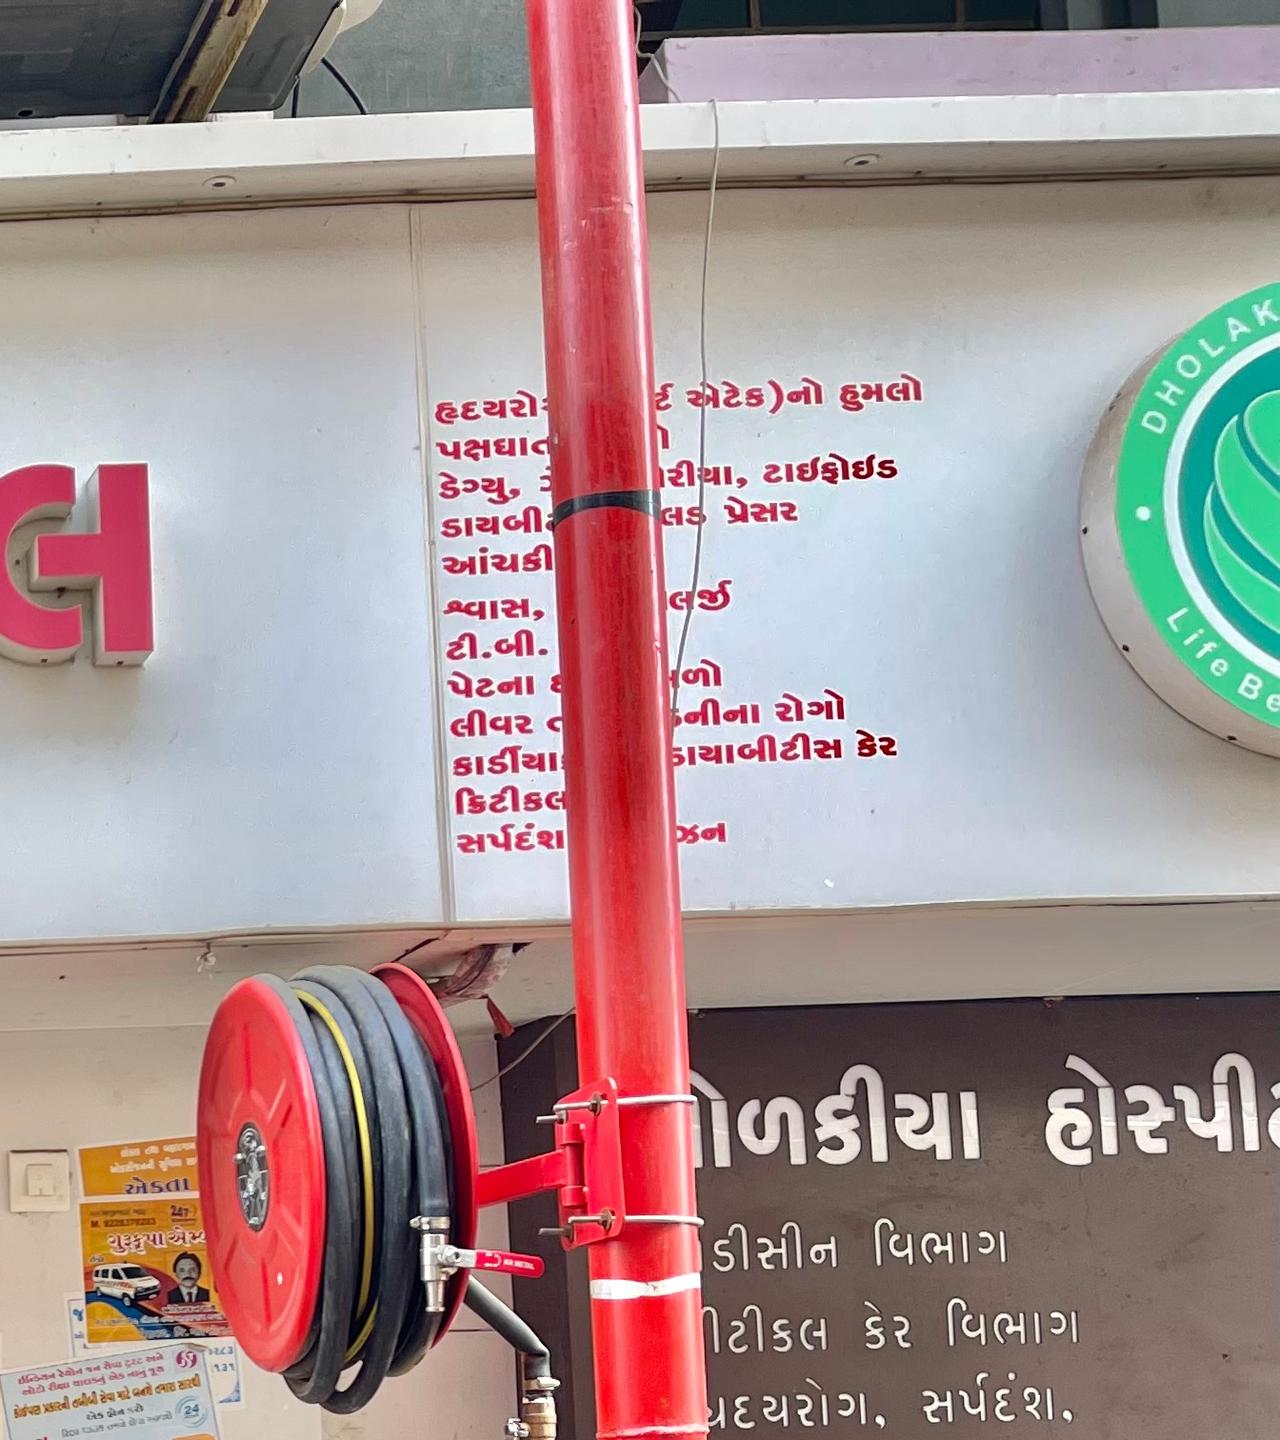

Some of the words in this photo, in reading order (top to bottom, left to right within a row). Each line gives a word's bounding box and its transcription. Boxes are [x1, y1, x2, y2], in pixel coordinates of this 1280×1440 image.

[840, 373, 923, 412] હુમલો
[762, 452, 898, 485] ટાઈફોઈડ
[446, 628, 548, 661] ટી.બી.
[1166, 606, 1230, 679] Life
[447, 670, 536, 699] પેટના
[450, 708, 534, 738] લીવર
[774, 688, 845, 723] રોગો
[452, 745, 567, 777] કાર્ડીયા
[855, 729, 897, 758] કેર
[689, 1063, 981, 1168] ોળકીયા
[699, 1221, 839, 1272] ડીસીન
[873, 1217, 1008, 1267] વિભાગ
[863, 1300, 913, 1350] કેર
[945, 1296, 1080, 1347] વિભાગ
